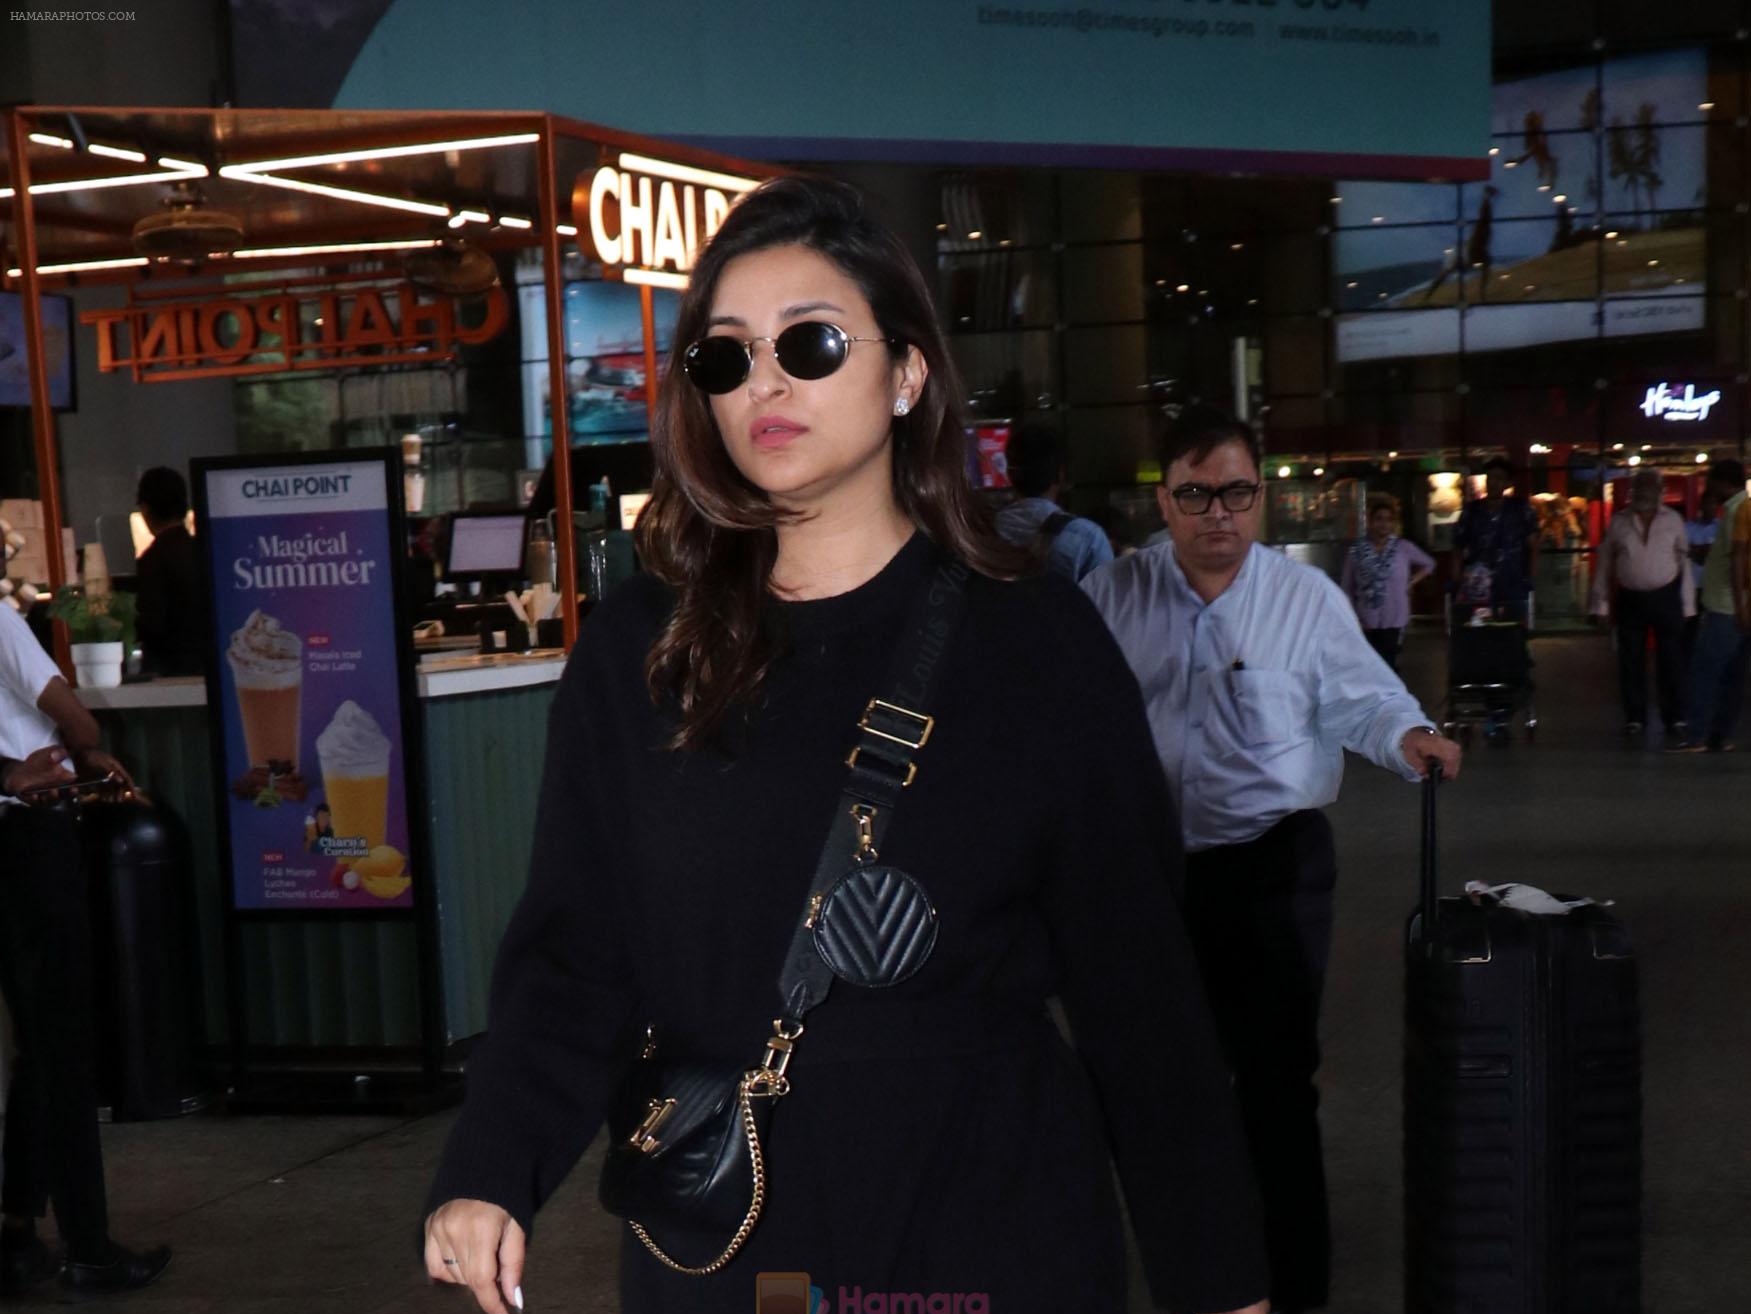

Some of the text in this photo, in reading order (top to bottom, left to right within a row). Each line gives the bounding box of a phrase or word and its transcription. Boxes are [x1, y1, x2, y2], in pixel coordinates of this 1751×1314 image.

[590, 165, 698, 272] CHAI
[241, 474, 352, 498] CHAI POINT
[256, 531, 348, 562] Magical
[233, 557, 375, 590] Summer
